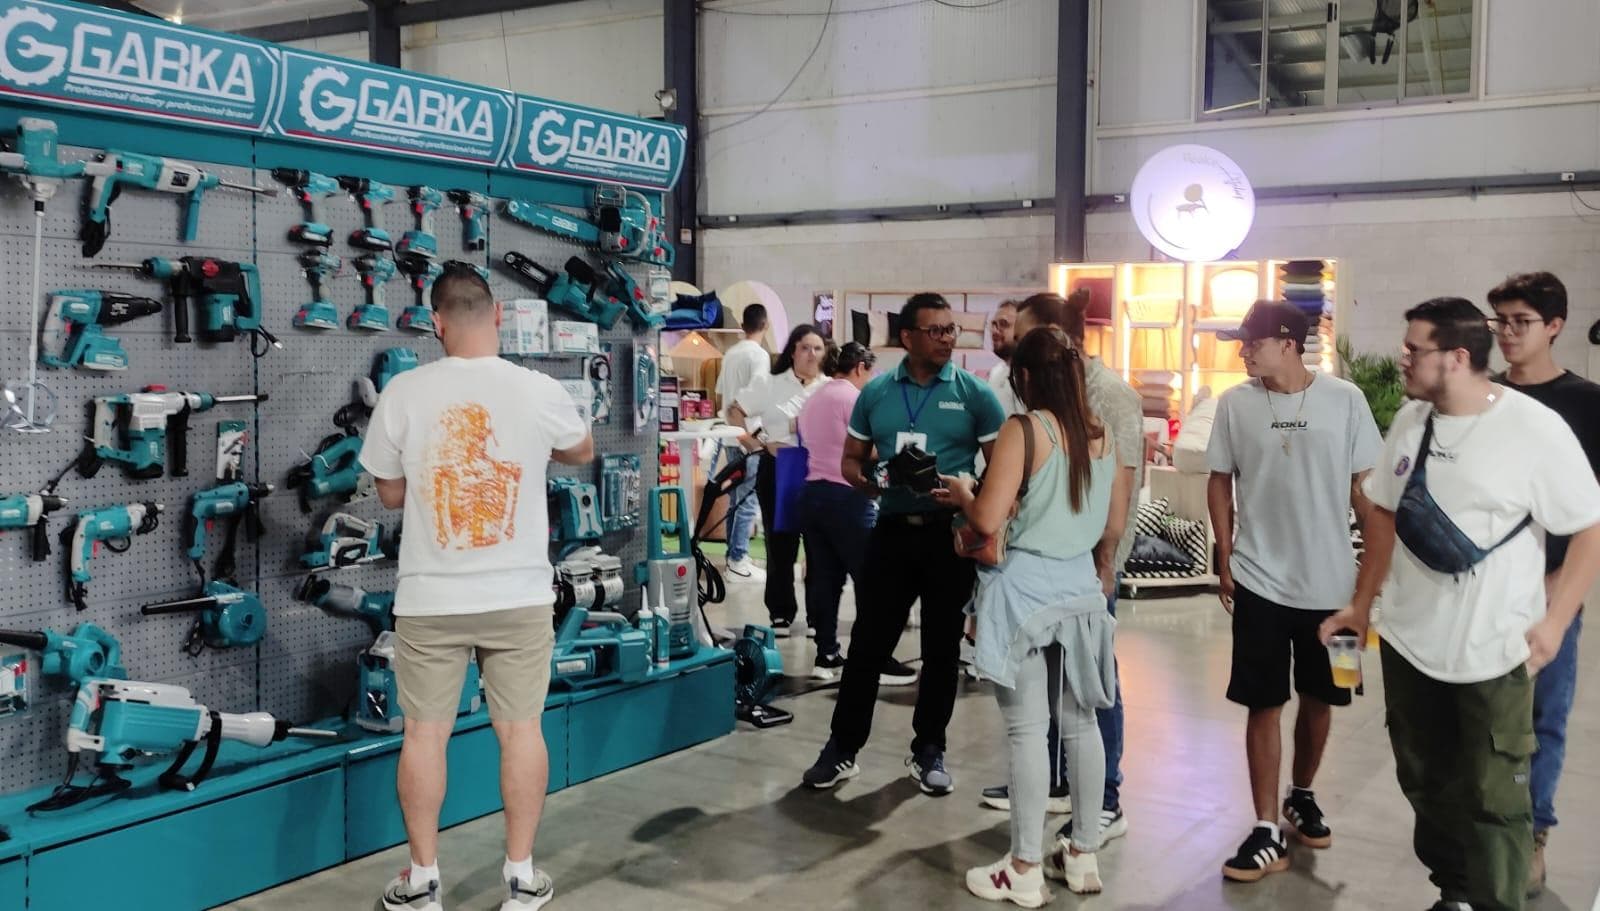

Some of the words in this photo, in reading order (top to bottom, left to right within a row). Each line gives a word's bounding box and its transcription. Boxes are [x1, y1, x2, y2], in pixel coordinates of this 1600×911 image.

[70, 23, 256, 103] GARKA
[63, 83, 129, 101] Professional
[129, 94, 165, 107] factory
[166, 101, 225, 115] professional
[225, 110, 254, 120] brand
[357, 78, 494, 142] GARKA
[569, 118, 671, 171] GARKA
[1270, 420, 1308, 429] ROKU
